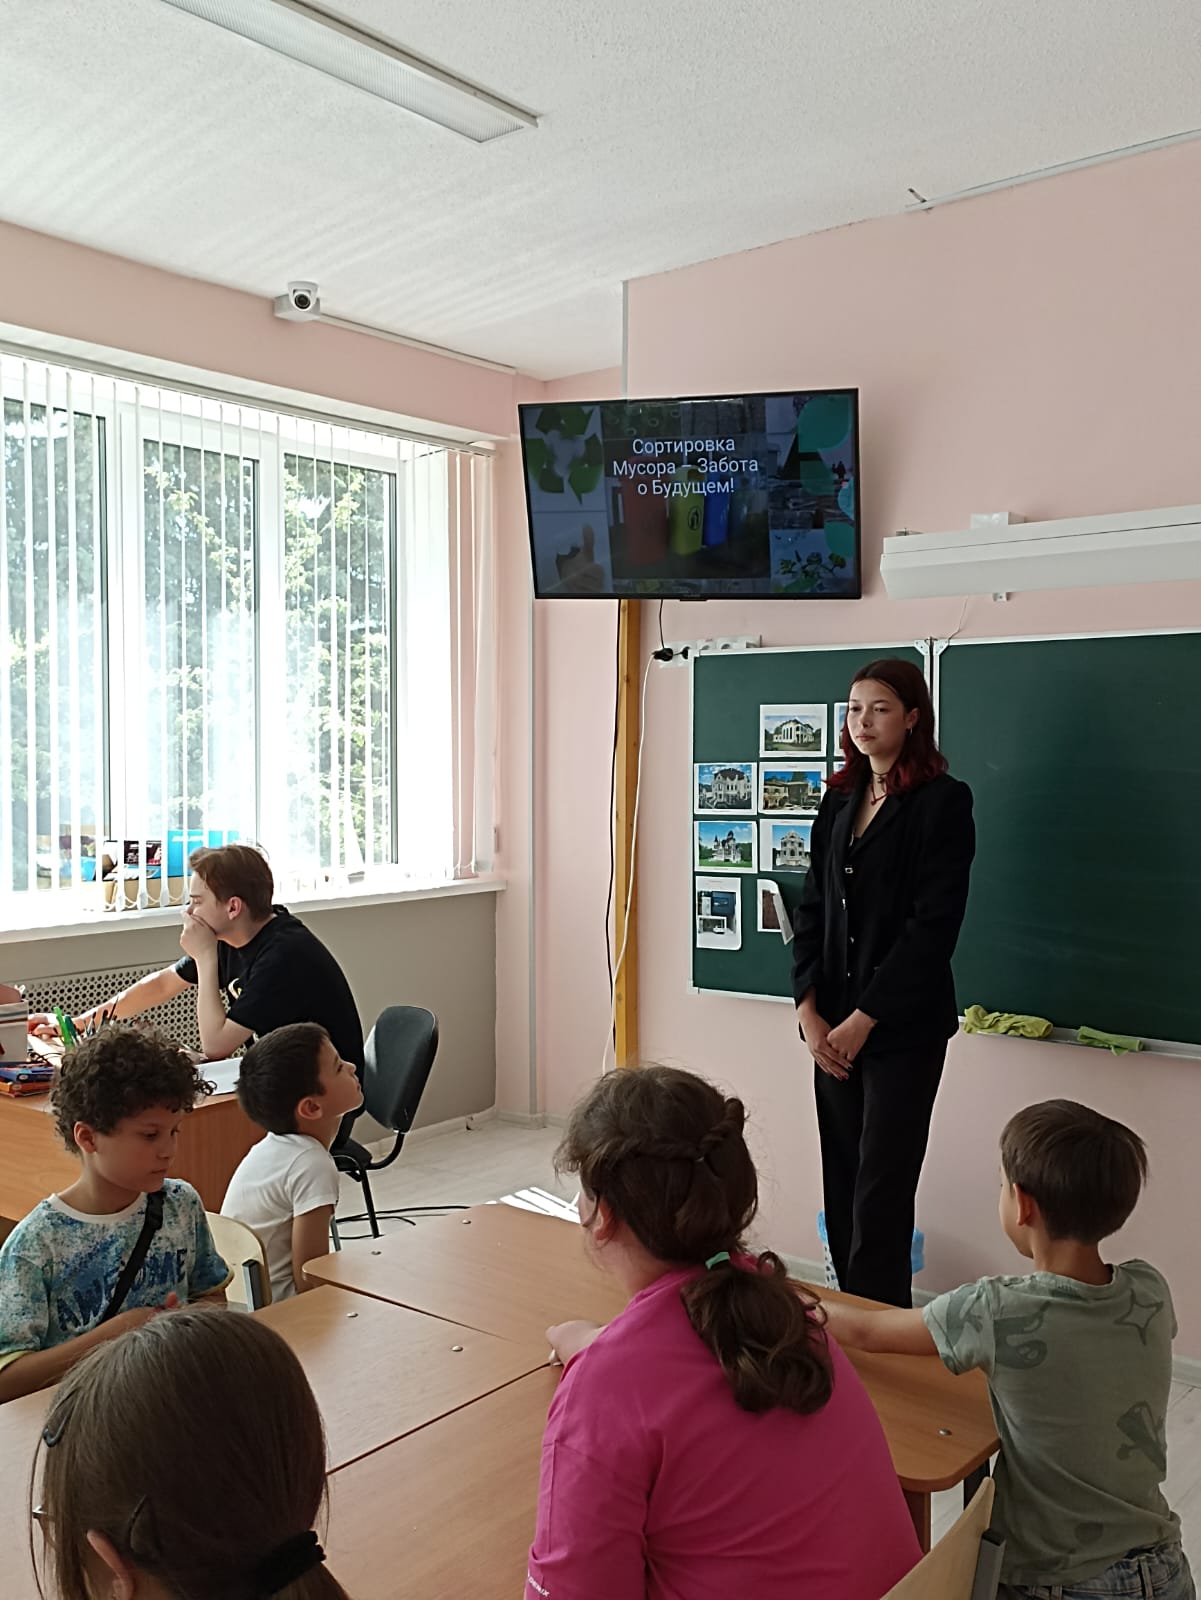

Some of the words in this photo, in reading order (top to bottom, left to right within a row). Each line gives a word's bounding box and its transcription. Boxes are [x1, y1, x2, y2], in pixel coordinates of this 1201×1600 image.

[632, 439, 736, 457] Сортировка
[613, 460, 677, 479] Мусора
[697, 456, 759, 473] Забота
[637, 482, 648, 495] о
[652, 477, 735, 498] Будущем!
